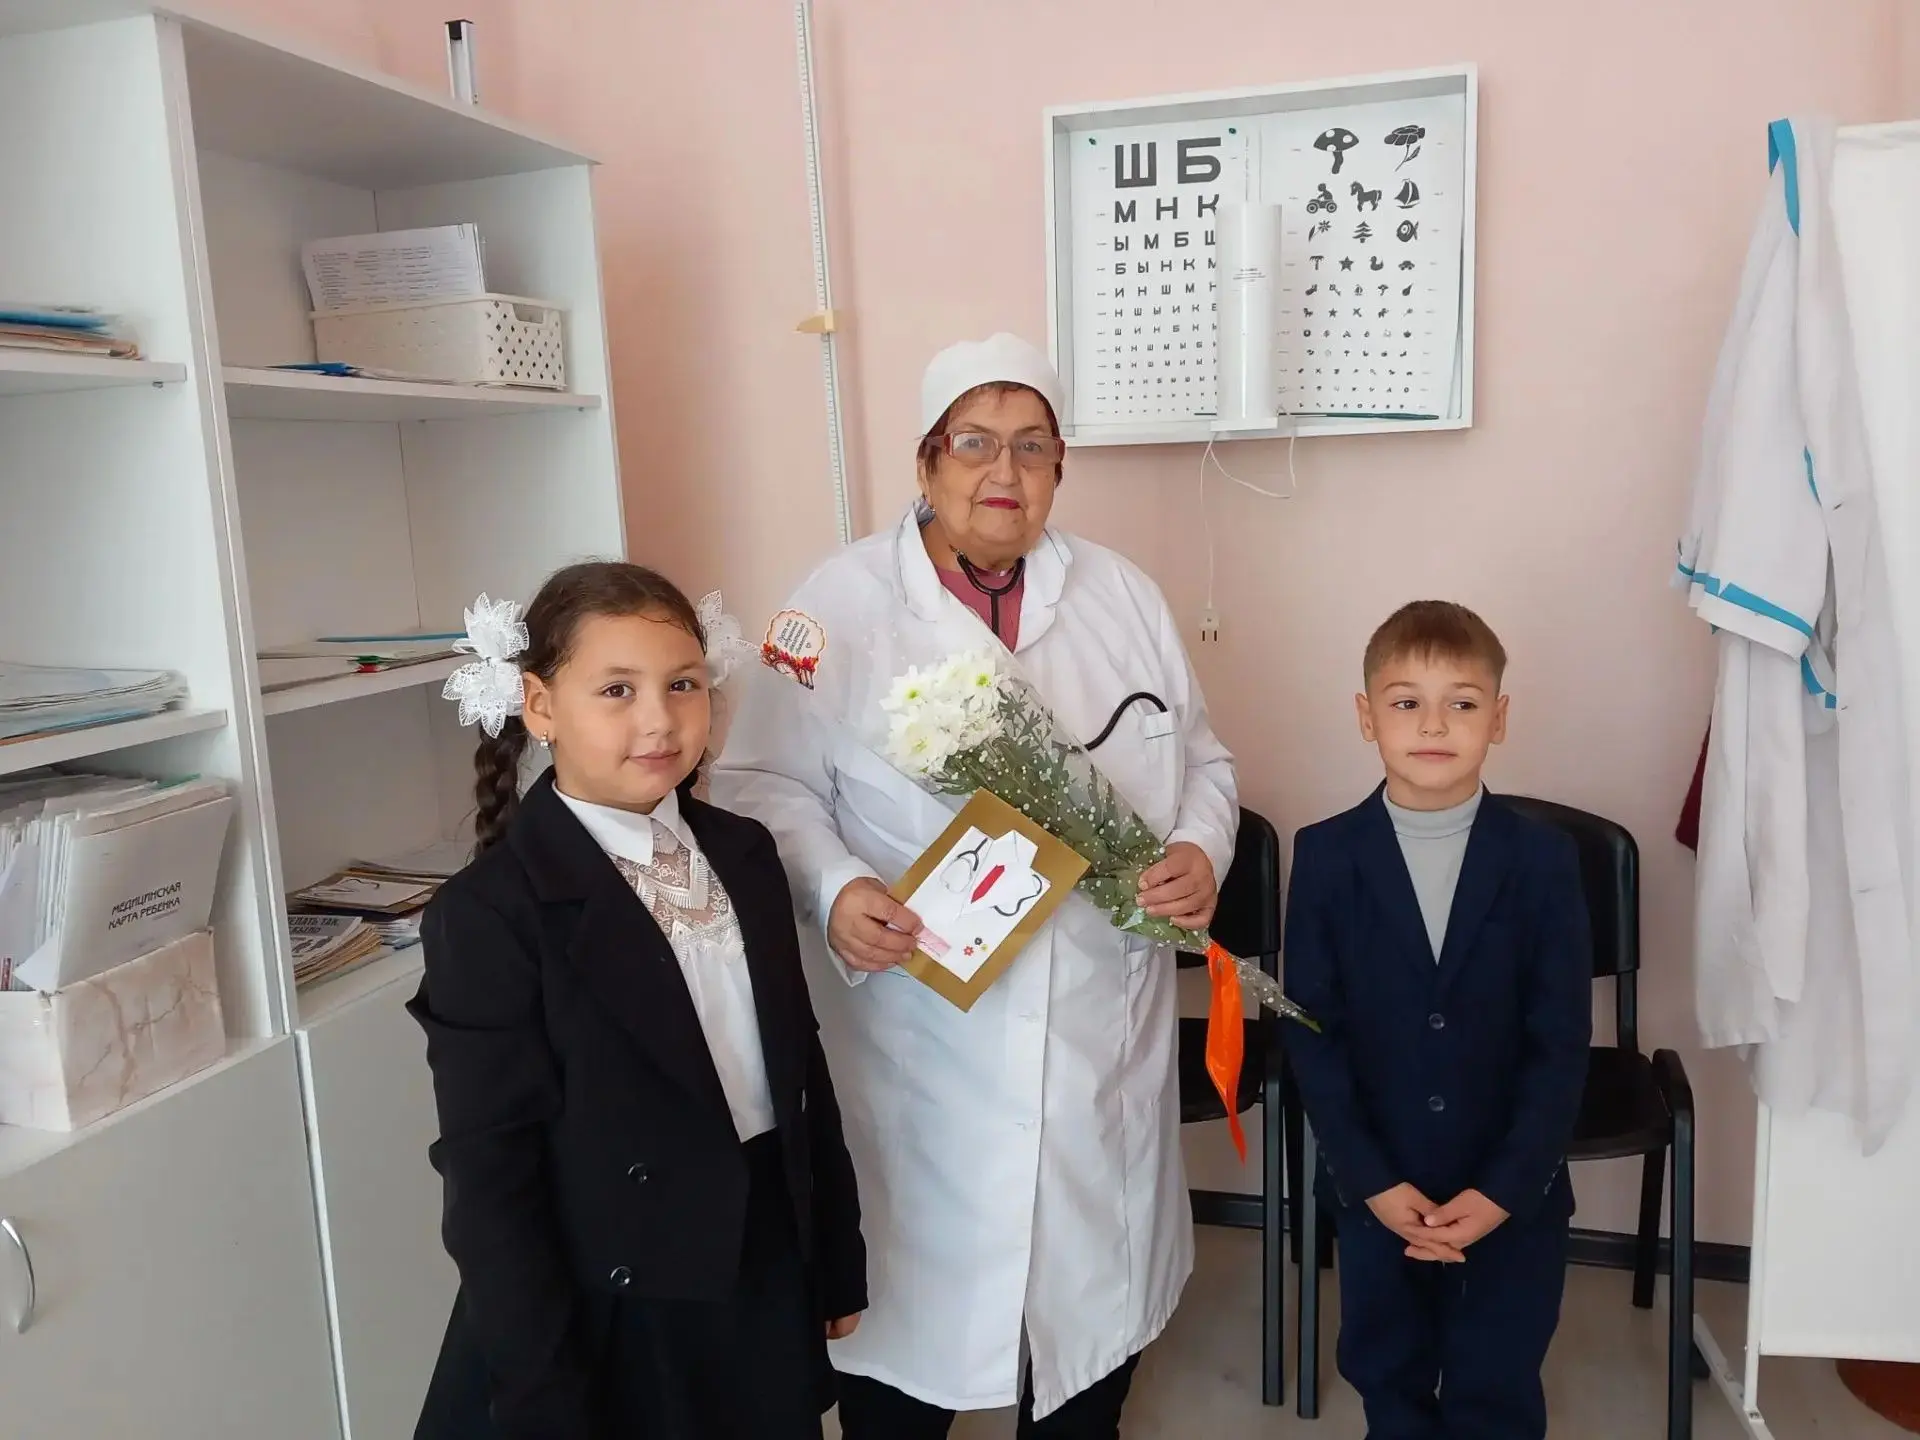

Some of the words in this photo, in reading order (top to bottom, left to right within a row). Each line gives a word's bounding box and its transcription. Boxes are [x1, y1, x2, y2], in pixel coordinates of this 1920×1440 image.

[1115, 141, 1157, 189] Ш
[1177, 136, 1222, 185] Б
[1114, 199, 1137, 224] М
[1155, 196, 1179, 221] Н
[1197, 193, 1220, 218] К
[1114, 235, 1129, 252] Ы
[1143, 233, 1159, 250] М
[1173, 231, 1190, 248] Б
[1114, 262, 1127, 275] Б
[1137, 261, 1149, 274] Ы
[1160, 259, 1173, 273] Н
[1183, 257, 1196, 271] К
[1114, 287, 1125, 299] И
[1137, 285, 1148, 297] Н
[1160, 283, 1172, 295] Ш
[1185, 282, 1195, 294] М
[1114, 308, 1123, 318] Н
[111, 881, 182, 915] МЕДИЦИНСКАЯ
[108, 911, 139, 930] КАРТА
[140, 896, 181, 918] РЕБЕНКА
